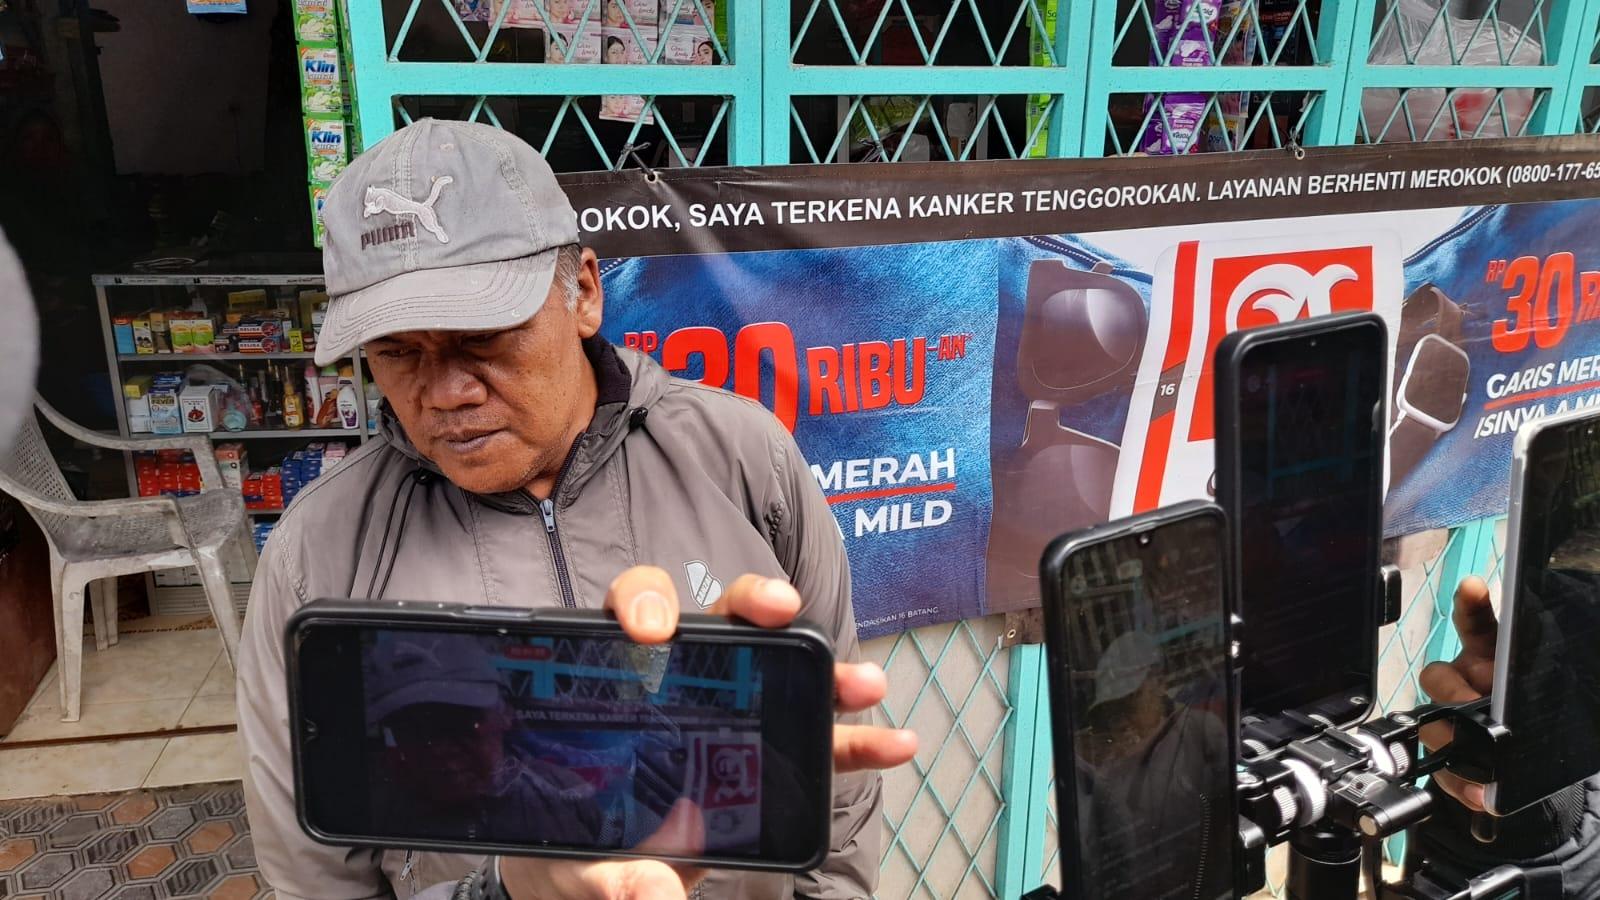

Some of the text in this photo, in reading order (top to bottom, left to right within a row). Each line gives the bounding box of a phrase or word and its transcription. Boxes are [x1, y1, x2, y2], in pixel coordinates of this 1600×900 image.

[305, 60, 336, 73] Klin
[311, 131, 342, 144] Klin
[577, 204, 680, 233] OKOK,
[688, 202, 765, 228] SAYA
[770, 197, 902, 225] TERKENA
[908, 191, 1014, 218] KANKER
[1021, 182, 1201, 213] TENGGOROKAN.
[1207, 176, 1302, 202] LAYANAN
[1307, 170, 1405, 195] BERHENTI
[1410, 166, 1503, 190] MEROKOK
[1485, 259, 1507, 283] RP
[1491, 251, 1575, 353] 30
[624, 331, 658, 353] RP
[1159, 382, 1177, 397] 16
[1486, 362, 1556, 399] GARIS
[809, 447, 956, 490] MERAH
[855, 499, 953, 538] MILD
